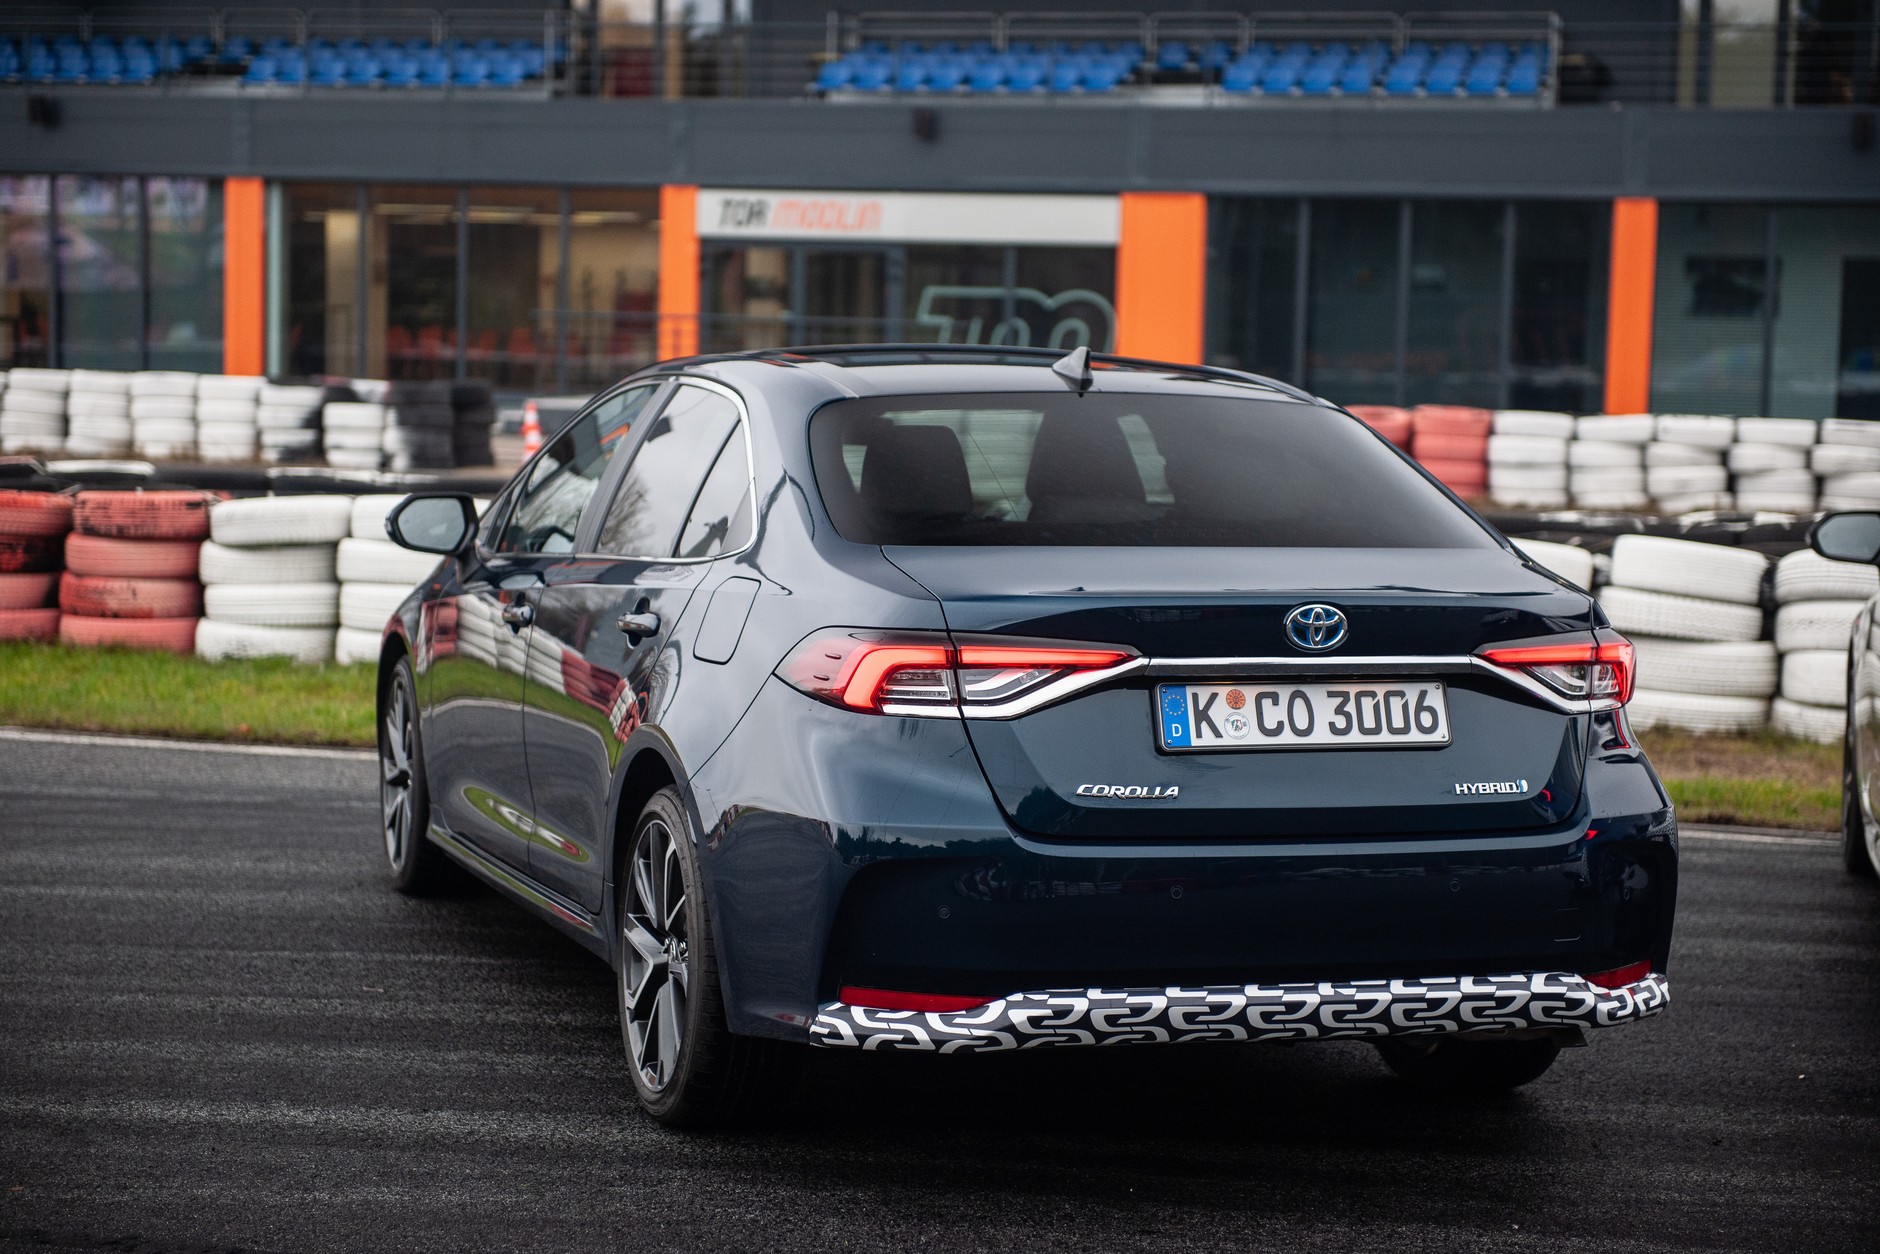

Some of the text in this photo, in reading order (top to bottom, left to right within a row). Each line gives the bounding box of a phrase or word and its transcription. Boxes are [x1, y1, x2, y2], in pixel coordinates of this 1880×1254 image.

[718, 198, 768, 227] TOR
[1192, 692, 1224, 738] K
[1254, 689, 1315, 738] CO
[1326, 689, 1440, 735] 3006
[1171, 723, 1182, 738] D
[1076, 784, 1179, 799] COROLLA
[1455, 781, 1518, 795] HYBRID
